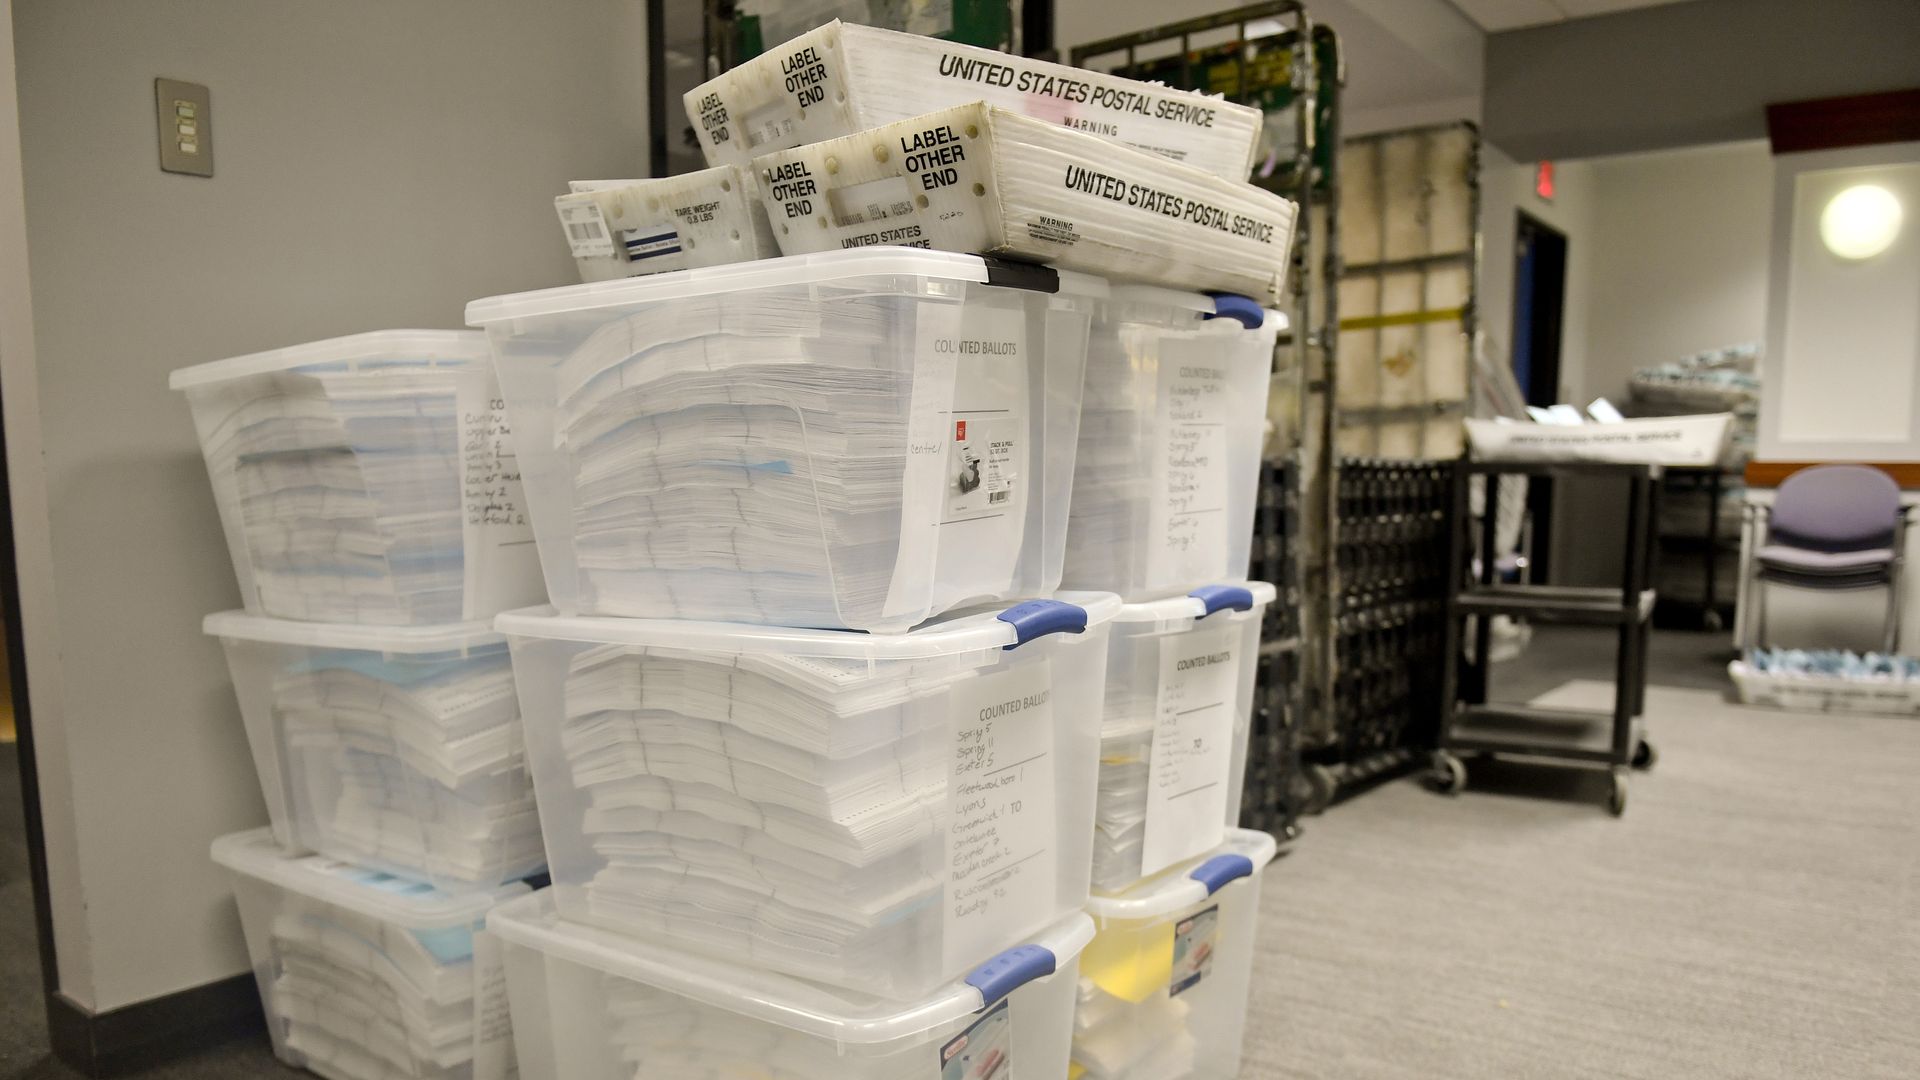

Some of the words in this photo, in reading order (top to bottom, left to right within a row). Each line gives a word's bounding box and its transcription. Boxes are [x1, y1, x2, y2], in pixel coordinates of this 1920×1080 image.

[781, 47, 821, 75] LABEL
[785, 64, 827, 93] OTHER
[798, 86, 824, 108] END
[939, 54, 1014, 87] UNITED
[1017, 70, 1089, 104] STATES
[1091, 86, 1151, 116] POSTAL
[1155, 99, 1215, 128] SERVICE
[697, 92, 723, 114] LABEL
[702, 108, 729, 131] OTHER
[1064, 116, 1117, 136] WARNING
[712, 127, 729, 145] END
[901, 126, 959, 153] LABEL
[905, 144, 965, 173] OTHER
[768, 161, 811, 183] LABEL
[921, 168, 958, 190] END
[773, 179, 816, 201] OTHER
[675, 207, 692, 216] TARE
[693, 201, 720, 213] WEIGHT
[785, 199, 812, 218] END
[1065, 165, 1125, 201] UNITED
[1128, 184, 1182, 218] STATES
[1184, 201, 1229, 231] POSTAL
[1231, 214, 1273, 244] SERVICE
[699, 212, 713, 222] LBS
[1040, 216, 1073, 231] WARNING
[841, 233, 879, 249] UNITED
[880, 225, 921, 242] STATES
[935, 340, 980, 354] COUNTED
[982, 341, 1017, 355] BALLOTS
[1177, 656, 1206, 671] COUNTED
[980, 699, 1021, 721] COUNTED
[986, 722, 992, 733] 5
